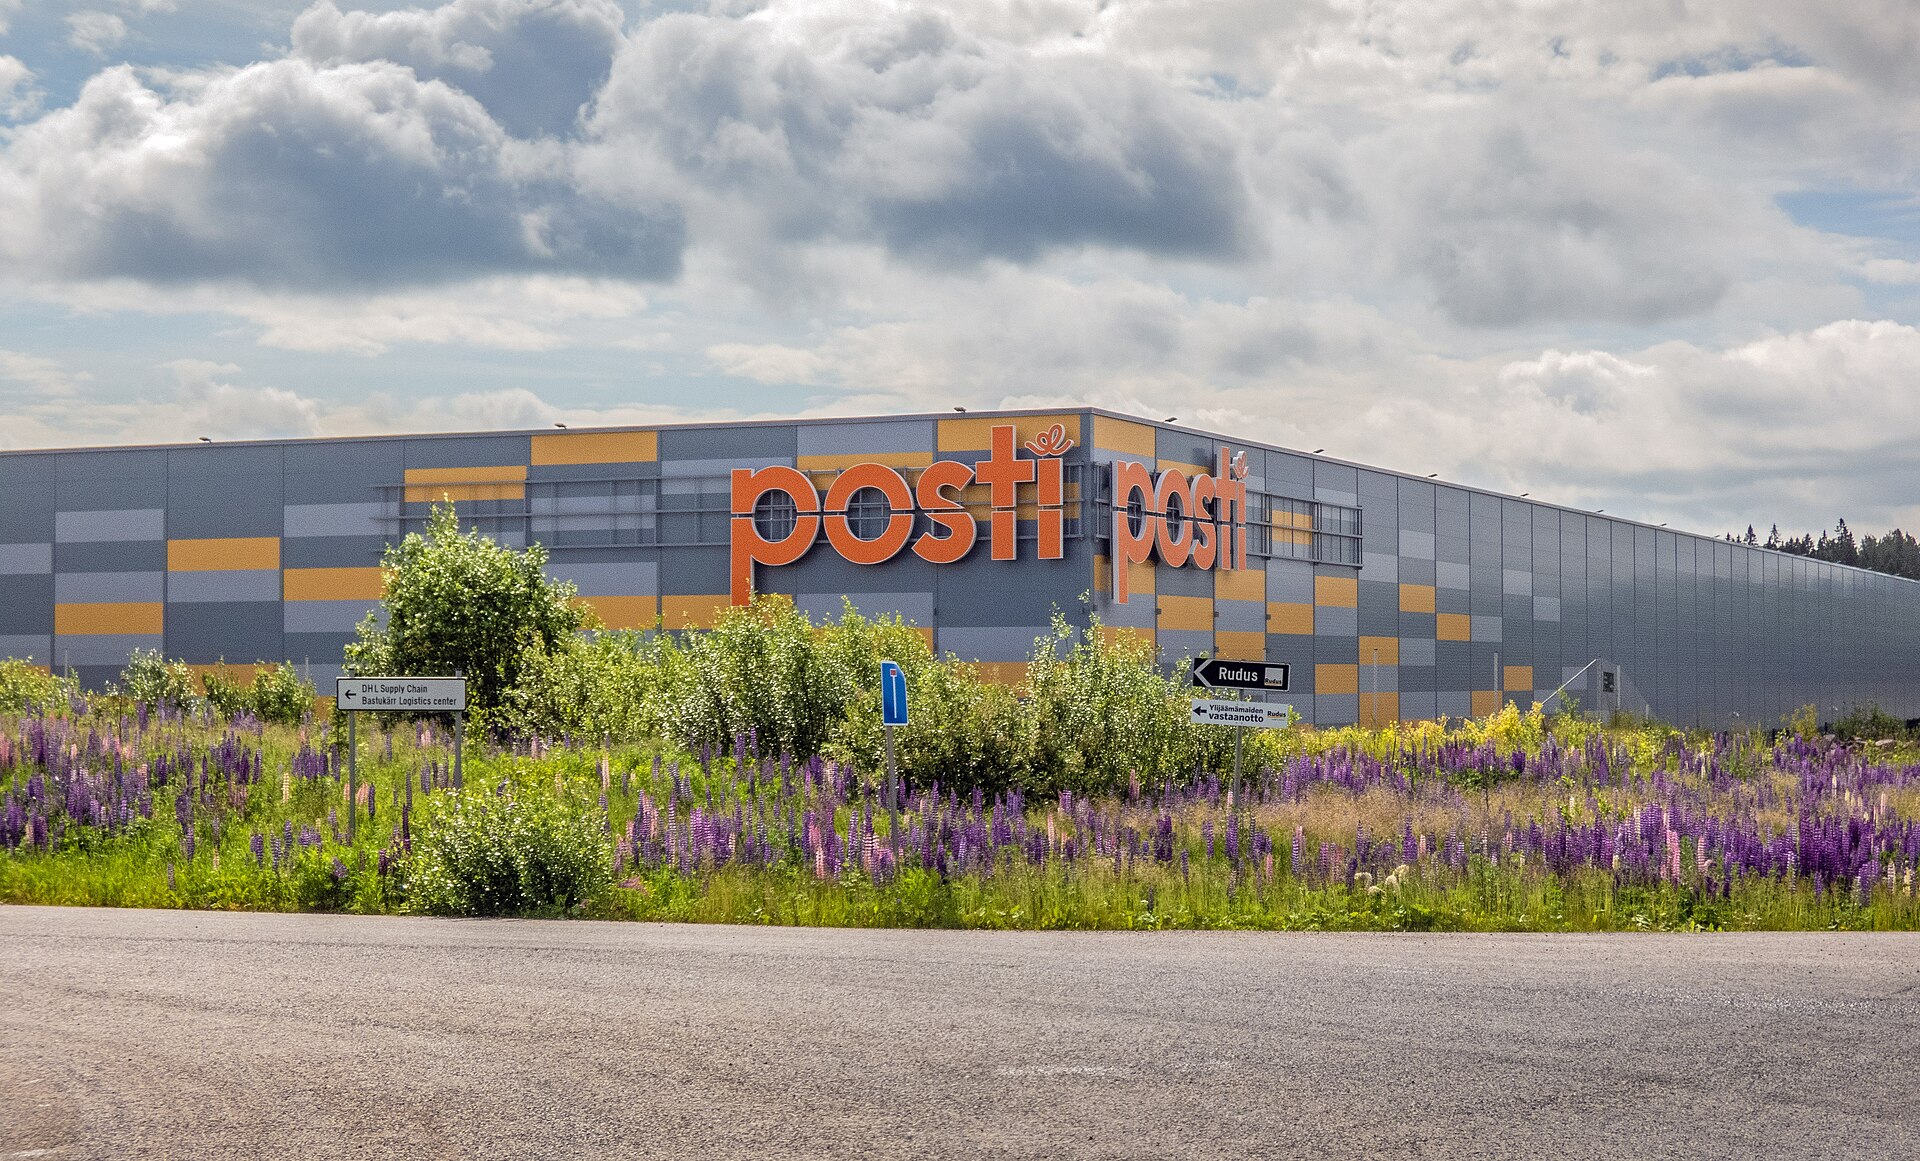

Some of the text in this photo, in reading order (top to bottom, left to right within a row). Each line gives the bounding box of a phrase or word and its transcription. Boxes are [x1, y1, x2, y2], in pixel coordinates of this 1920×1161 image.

[731, 424, 1074, 607] posti
[1113, 447, 1248, 604] posti
[1218, 667, 1258, 682] Rudus
[361, 684, 428, 695] DHL Supply Chain
[361, 696, 457, 706] Bastukärr Logistics center
[1209, 704, 1264, 714] Ylijäämämaiden
[1267, 710, 1287, 718] Rudus
[1208, 712, 1264, 723] vastaanotto
